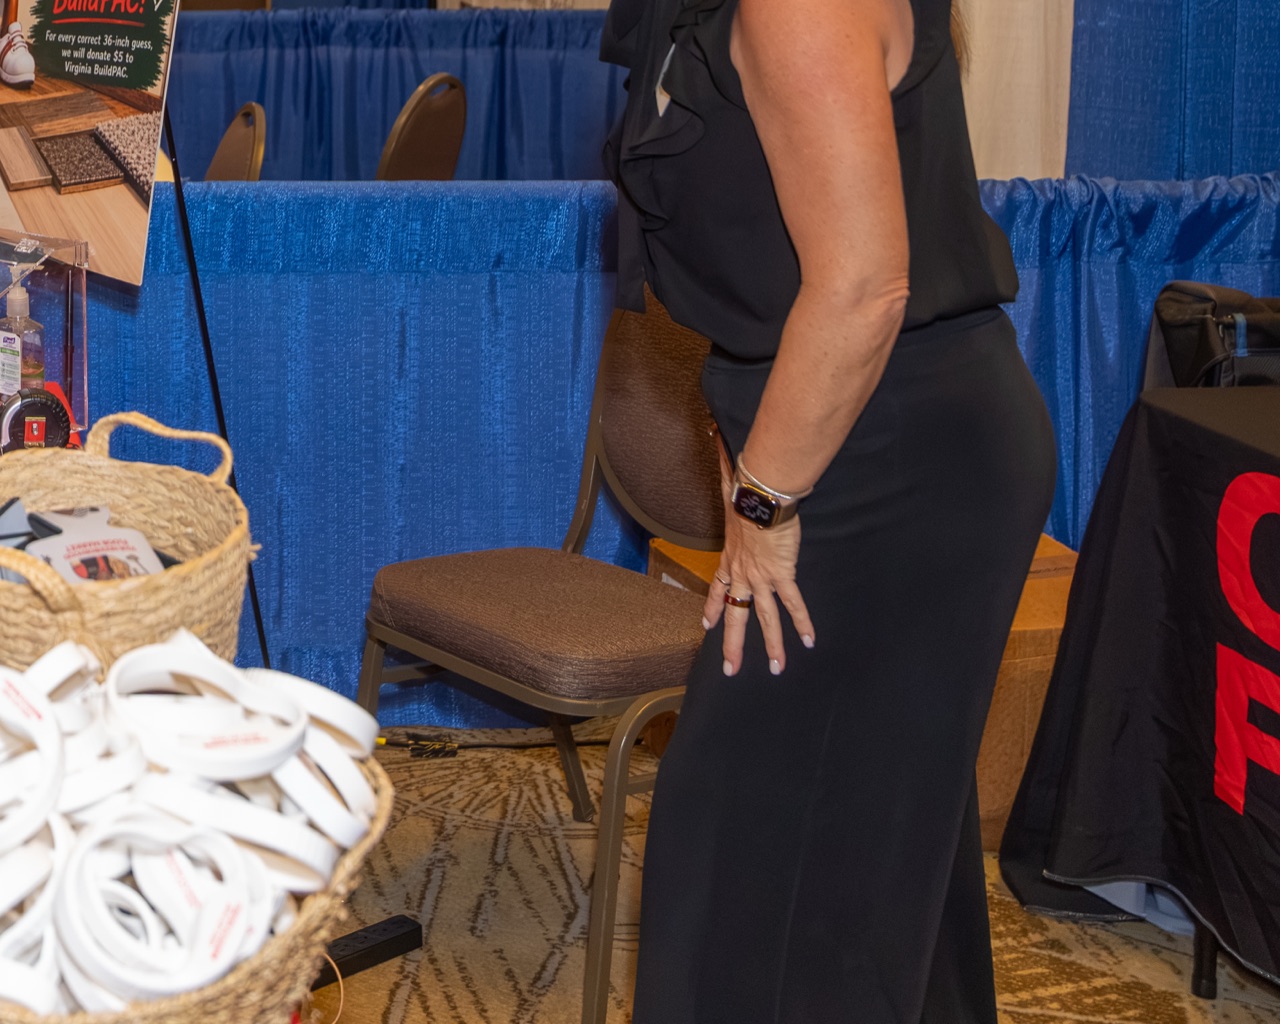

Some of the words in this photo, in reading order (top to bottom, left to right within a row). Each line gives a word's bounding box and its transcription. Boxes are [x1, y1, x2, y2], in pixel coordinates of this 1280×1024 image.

[45, 30, 57, 41] For
[58, 33, 76, 45] every
[77, 34, 101, 45] correct
[103, 34, 130, 48] 36-inch
[131, 39, 154, 51] guess,
[61, 49, 71, 58] we
[72, 48, 85, 59] will
[86, 49, 111, 61] donate
[113, 51, 124, 63] $5
[125, 54, 134, 64] to
[64, 61, 92, 76] Virginia
[94, 64, 128, 78] BuildPAC.
